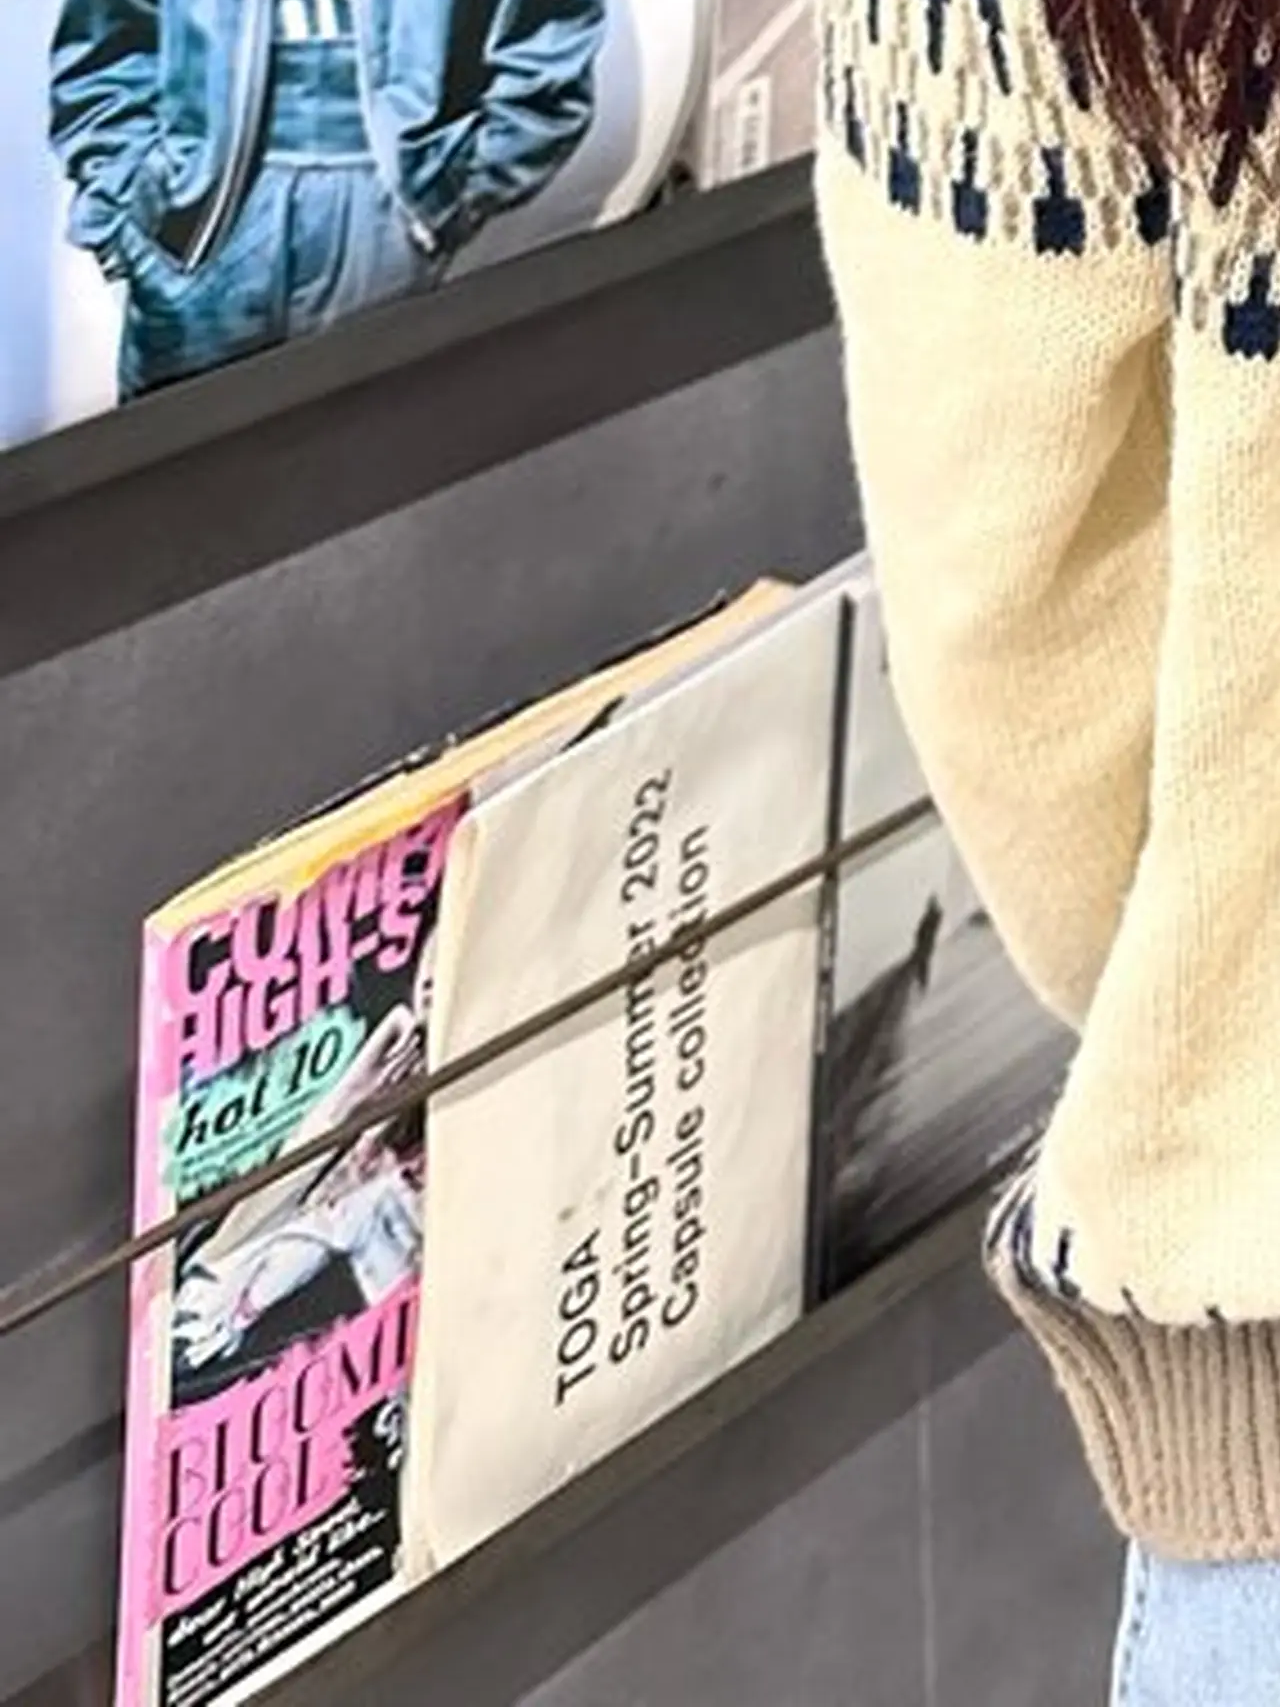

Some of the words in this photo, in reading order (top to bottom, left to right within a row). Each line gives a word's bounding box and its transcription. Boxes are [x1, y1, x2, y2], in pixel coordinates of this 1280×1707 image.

[621, 767, 673, 904] 2022
[289, 1025, 345, 1092] 10
[661, 1105, 707, 1329] Capsule
[556, 1228, 602, 1407] TOGA
